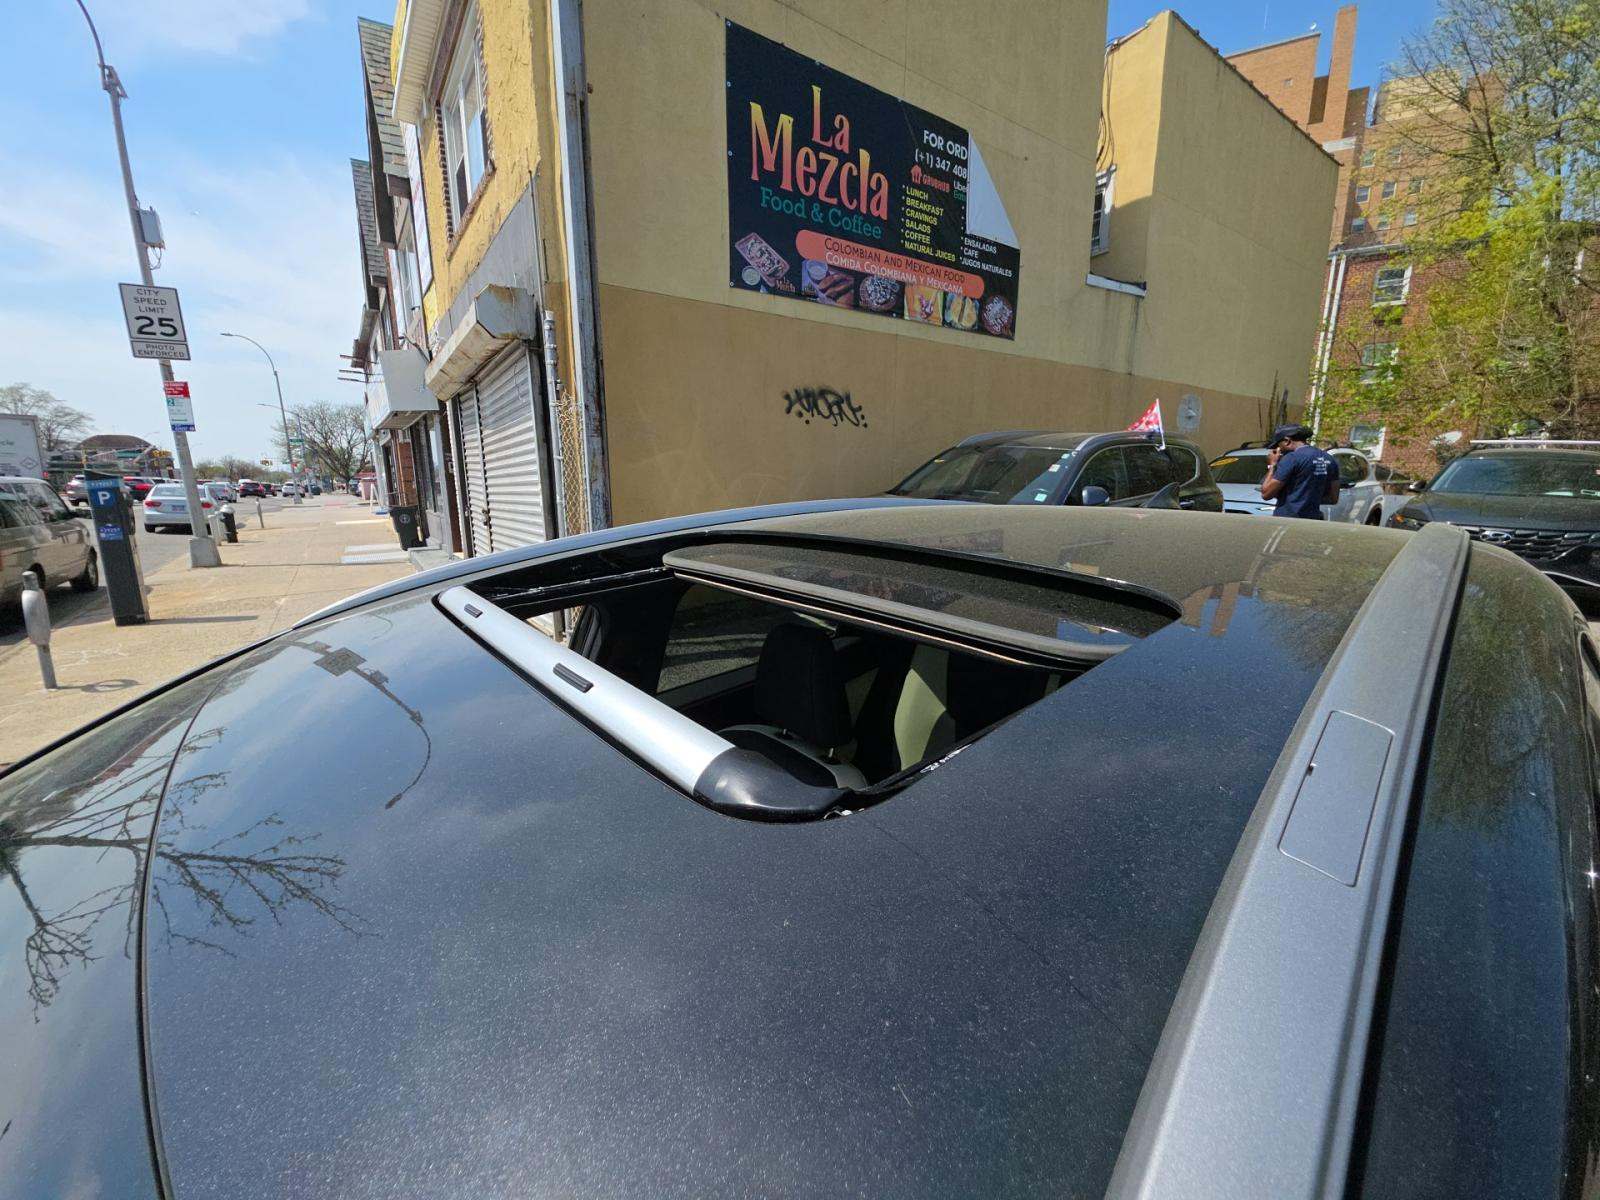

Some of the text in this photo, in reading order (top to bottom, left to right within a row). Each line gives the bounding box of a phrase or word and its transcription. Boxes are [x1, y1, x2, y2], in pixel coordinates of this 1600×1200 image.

[811, 85, 850, 153] La
[923, 130, 944, 151] FOR
[750, 101, 889, 220] Mezcla
[915, 149, 968, 179] (+1) 347 408
[906, 186, 929, 200] LUNCH
[760, 186, 882, 240] Food & Coffee
[905, 197, 944, 216] BREAKFAST
[905, 208, 938, 226] CRAVINGS
[905, 219, 931, 234] SALADS
[904, 230, 931, 244] COFFEE
[964, 237, 997, 254] ENSALADAS
[904, 241, 956, 262] NATURAL JUICES
[963, 247, 979, 258] CAFE
[824, 238, 966, 284] COLOMBIAN AND MEXICAN FOOD
[961, 256, 1012, 278] JUGOS NATURALES
[825, 251, 862, 272] COMIDA
[863, 261, 917, 284] COLOMBIANA
[926, 277, 964, 295] MEXICANA
[136, 288, 160, 296] CITY
[133, 297, 167, 306] SPEED
[138, 305, 165, 314] LIMIT
[134, 315, 178, 337] 25
[137, 349, 185, 358] ENFORCED
[145, 343, 175, 351] PHOTO
[97, 491, 111, 505] P
